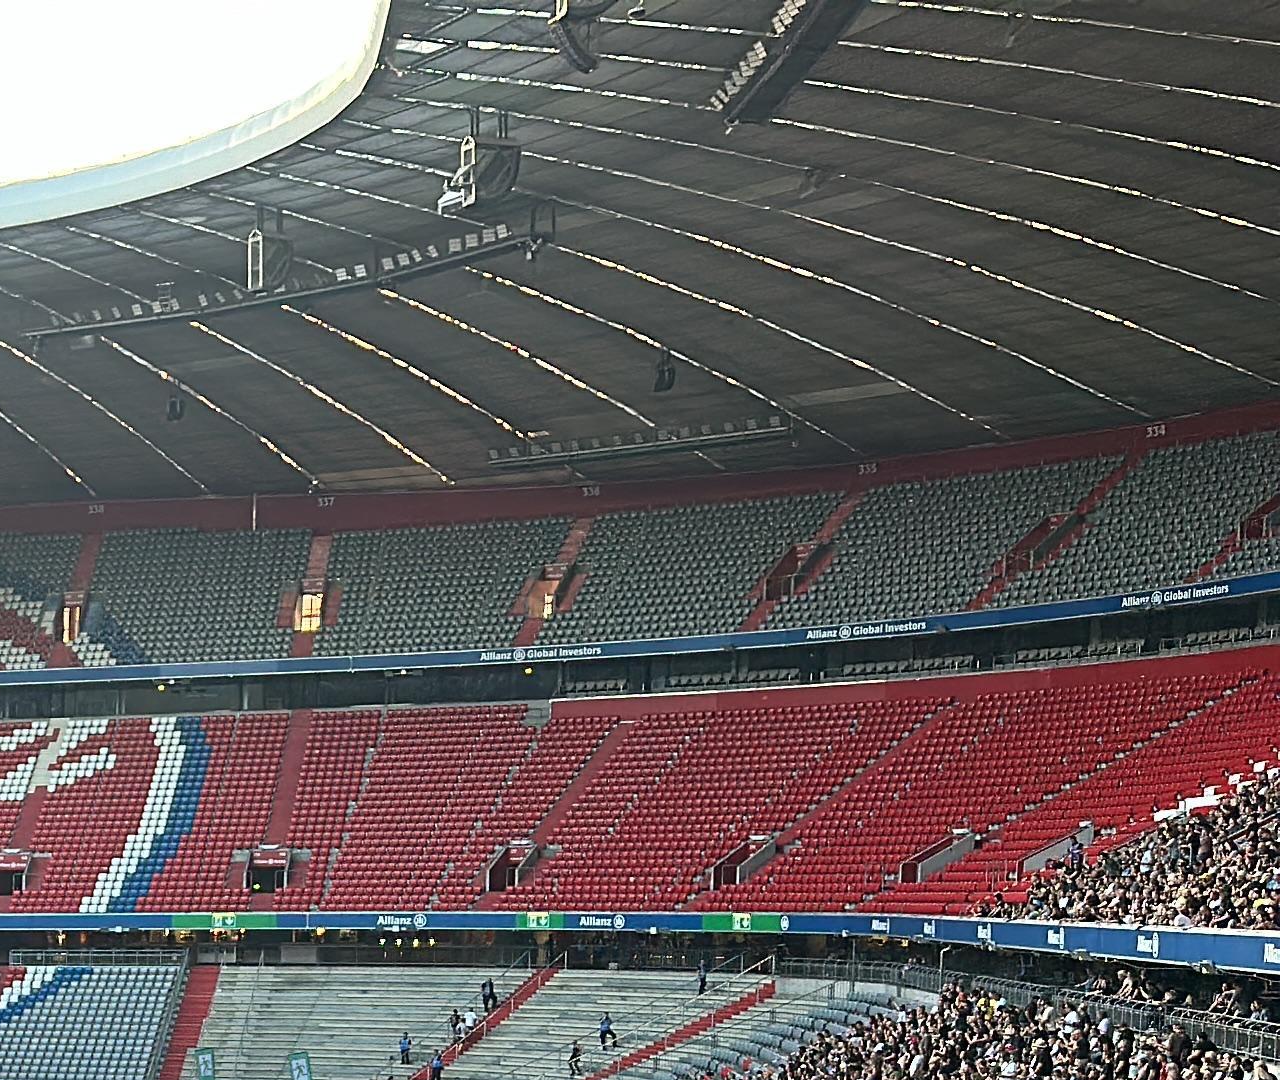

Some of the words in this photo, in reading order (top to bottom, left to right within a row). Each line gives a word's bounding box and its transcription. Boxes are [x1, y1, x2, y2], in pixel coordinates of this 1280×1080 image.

[1146, 424, 1165, 439] 334
[858, 463, 877, 475] 335
[318, 496, 334, 507] 337
[1121, 596, 1149, 608] Allianz
[1164, 589, 1191, 602] Global
[1192, 584, 1229, 597] Investors
[806, 629, 838, 640] Allianz
[853, 624, 883, 636] Global
[885, 621, 926, 632] Investors
[480, 651, 511, 661] Allianz
[527, 648, 557, 659] Global
[559, 646, 601, 657] Investors
[376, 915, 412, 925] Allianz
[579, 916, 612, 927] Allianz
